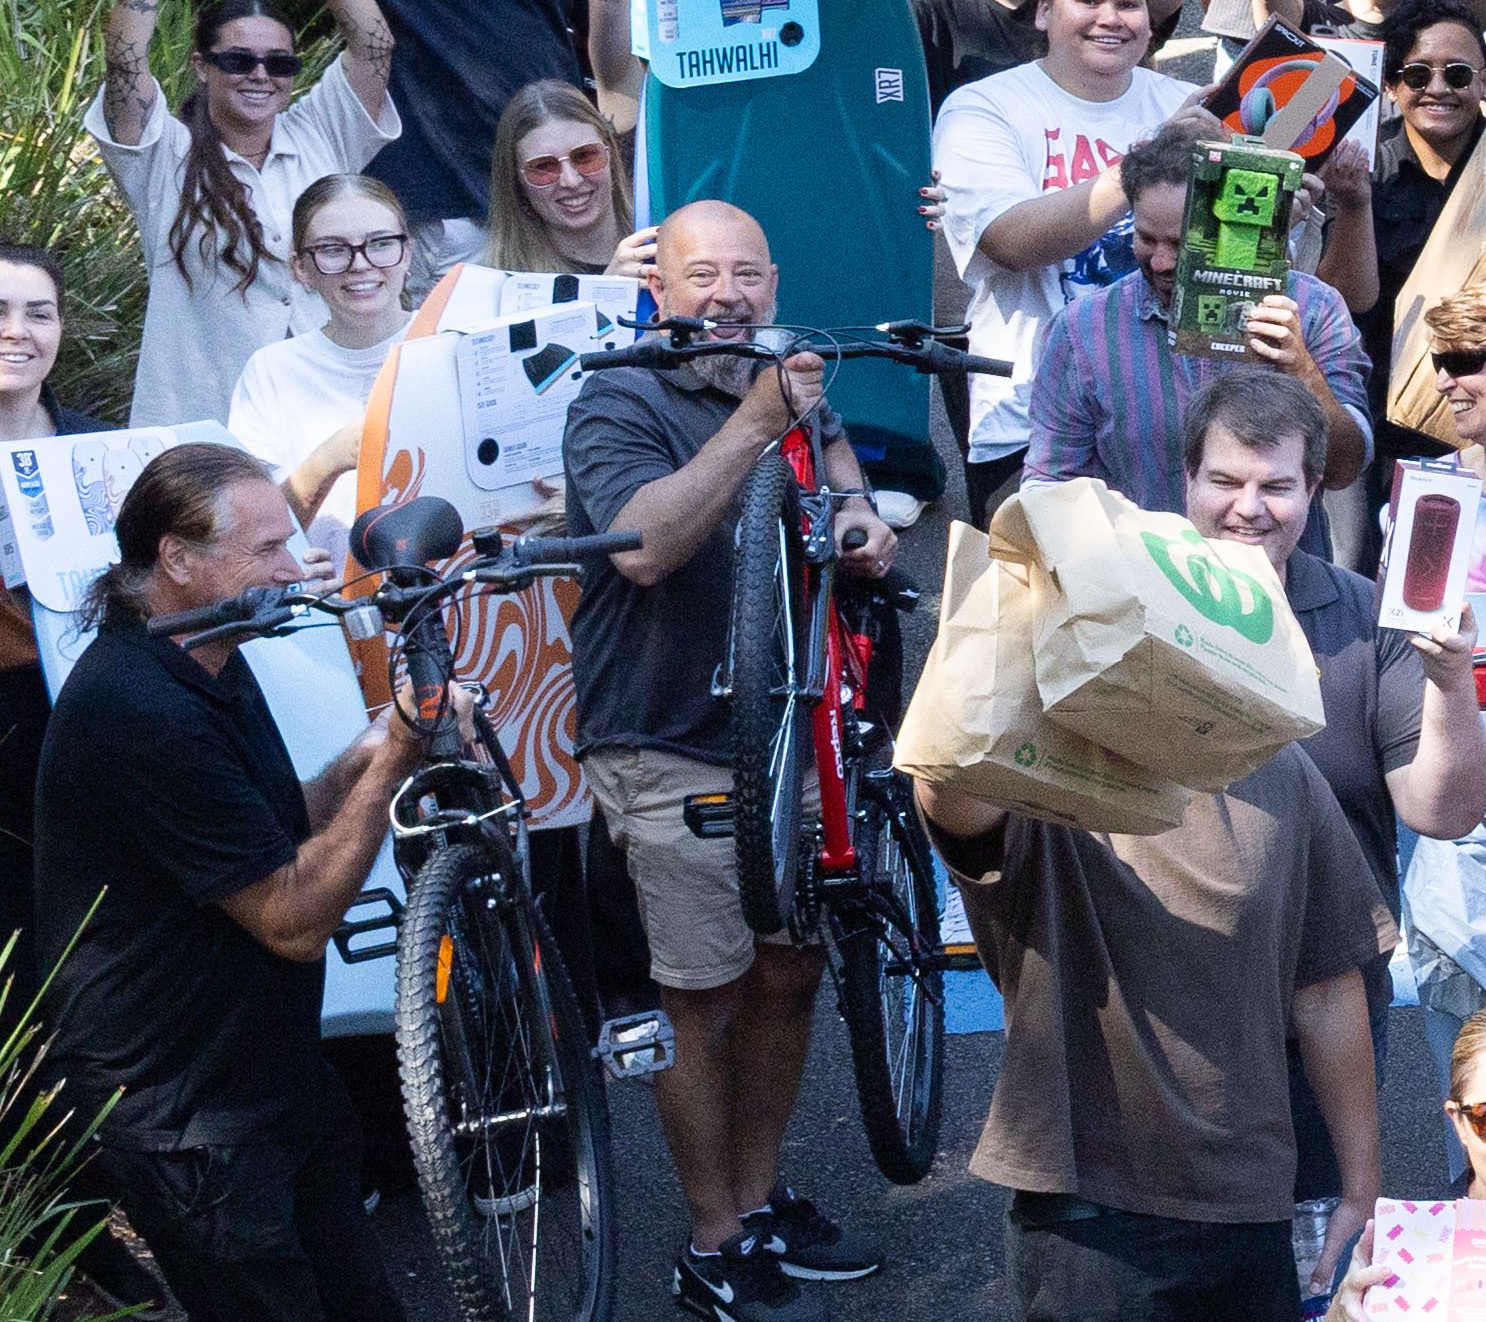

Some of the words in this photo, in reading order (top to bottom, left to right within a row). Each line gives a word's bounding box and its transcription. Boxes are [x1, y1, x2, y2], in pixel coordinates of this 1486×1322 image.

[1274, 23, 1306, 47] SPROUT
[677, 42, 780, 79] TAHWALHI
[879, 69, 902, 101] XR7
[1192, 269, 1283, 292] MINECRAFT
[1219, 288, 1252, 299] MOVIE
[829, 709, 844, 779] Repco
